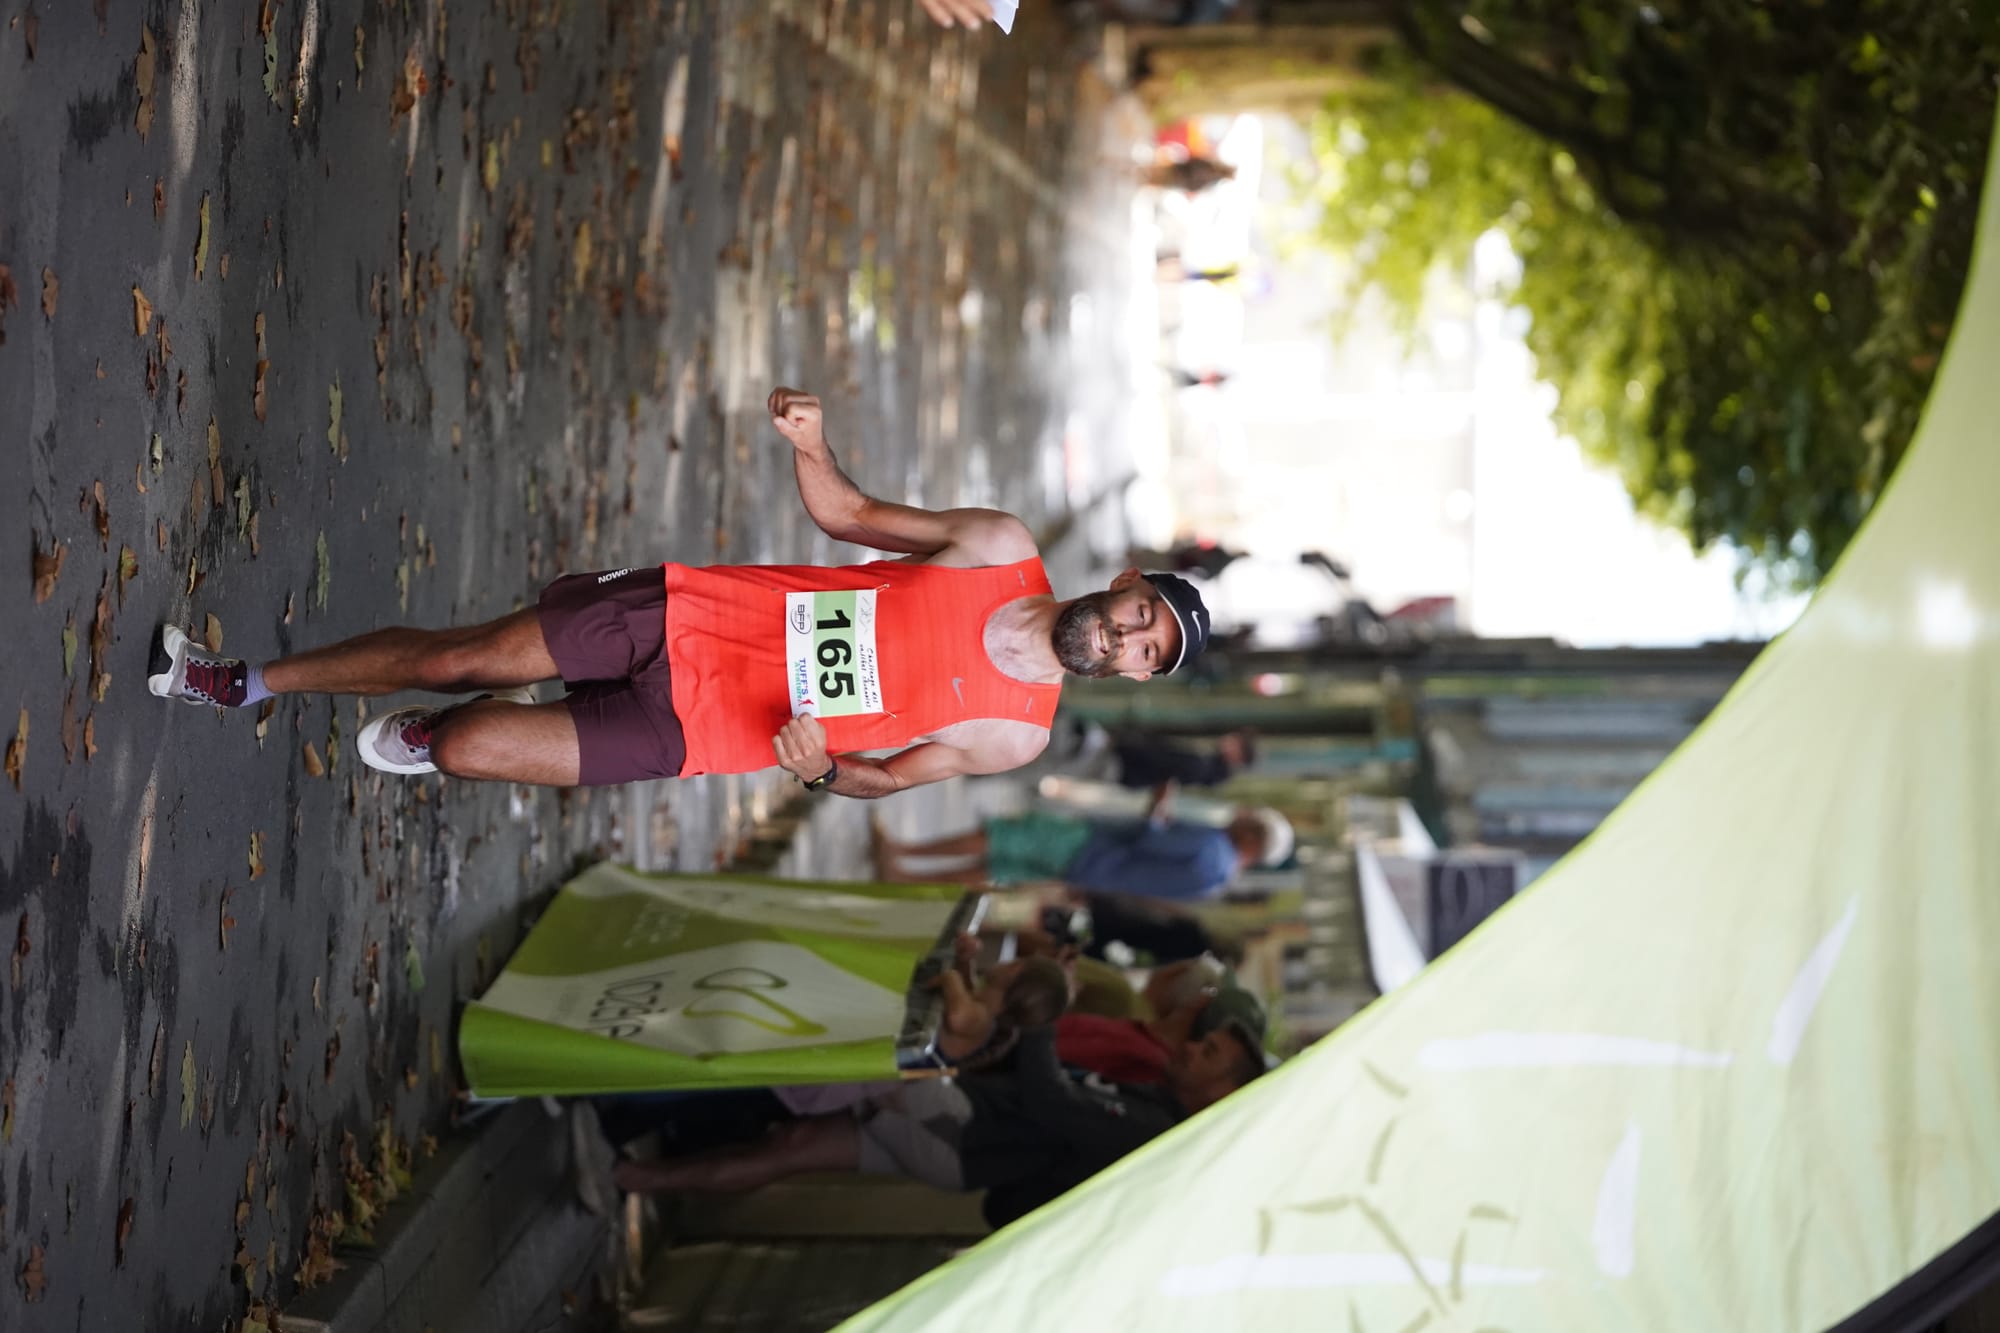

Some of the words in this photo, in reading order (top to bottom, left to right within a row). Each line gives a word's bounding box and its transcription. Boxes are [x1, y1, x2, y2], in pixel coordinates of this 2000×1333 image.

[797, 604, 805, 630] BFP
[816, 609, 855, 699] 165
[866, 648, 876, 687] Challenge
[799, 657, 808, 695] TUFF'S
